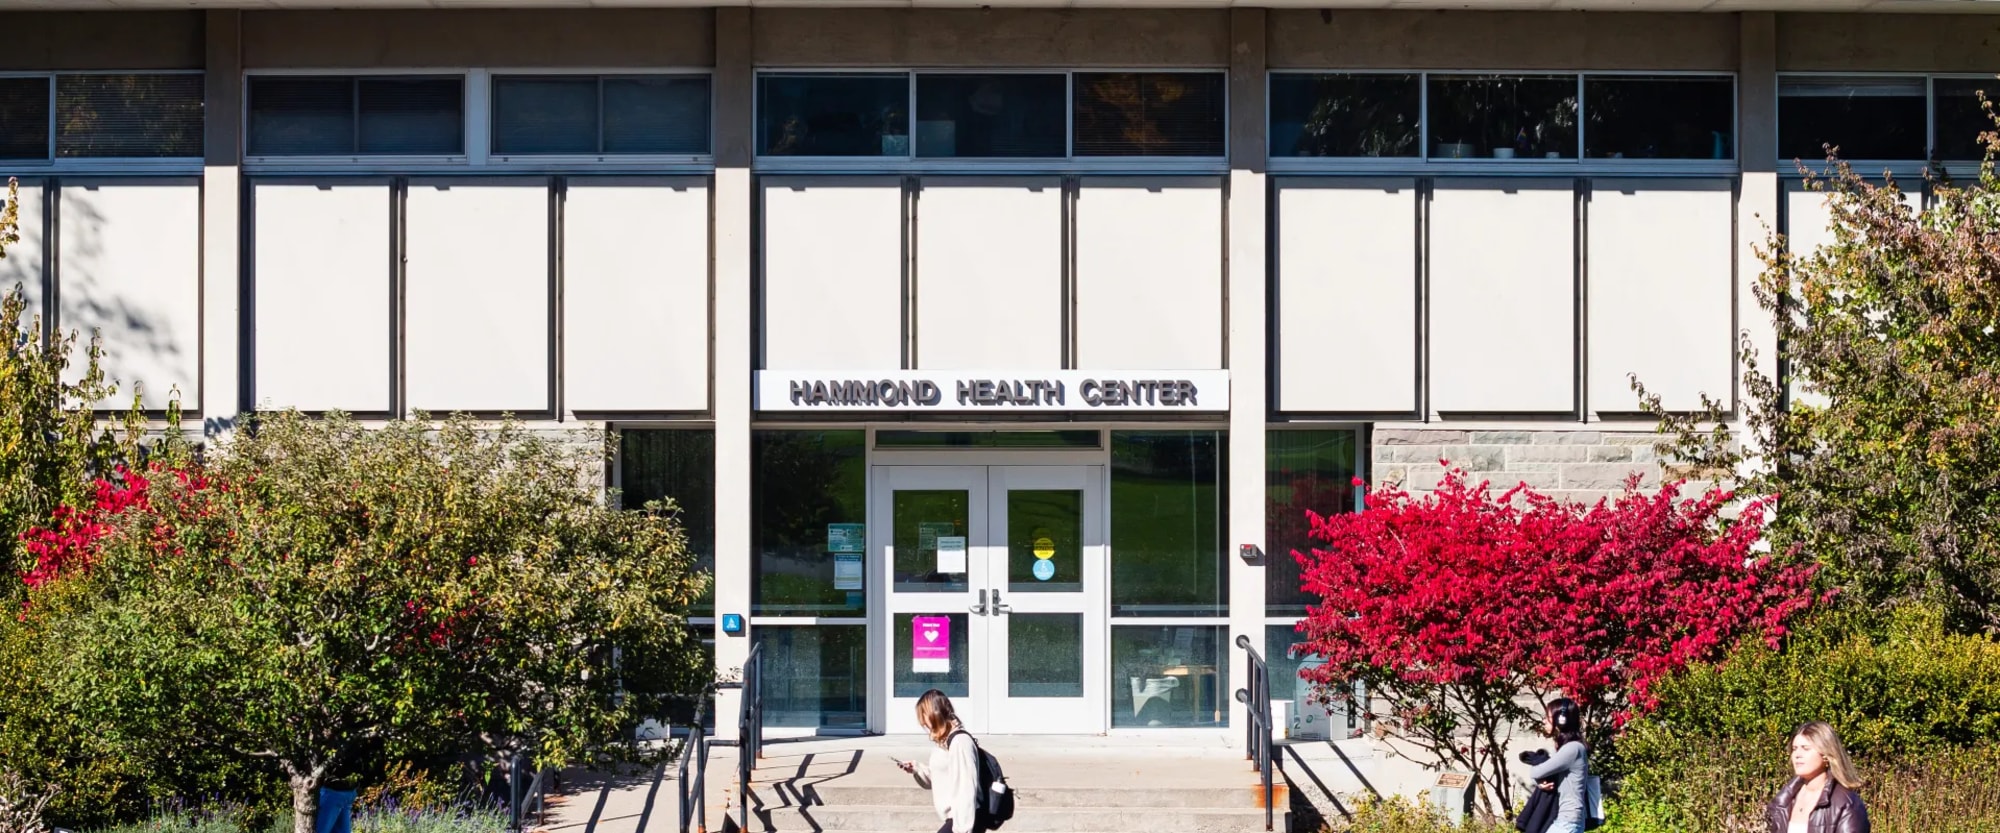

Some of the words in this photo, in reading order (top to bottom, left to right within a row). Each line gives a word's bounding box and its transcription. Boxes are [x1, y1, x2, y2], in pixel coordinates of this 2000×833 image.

[789, 379, 940, 406] HAMMOND
[956, 379, 1064, 406] HEALTH
[1079, 378, 1197, 406] CENTER
